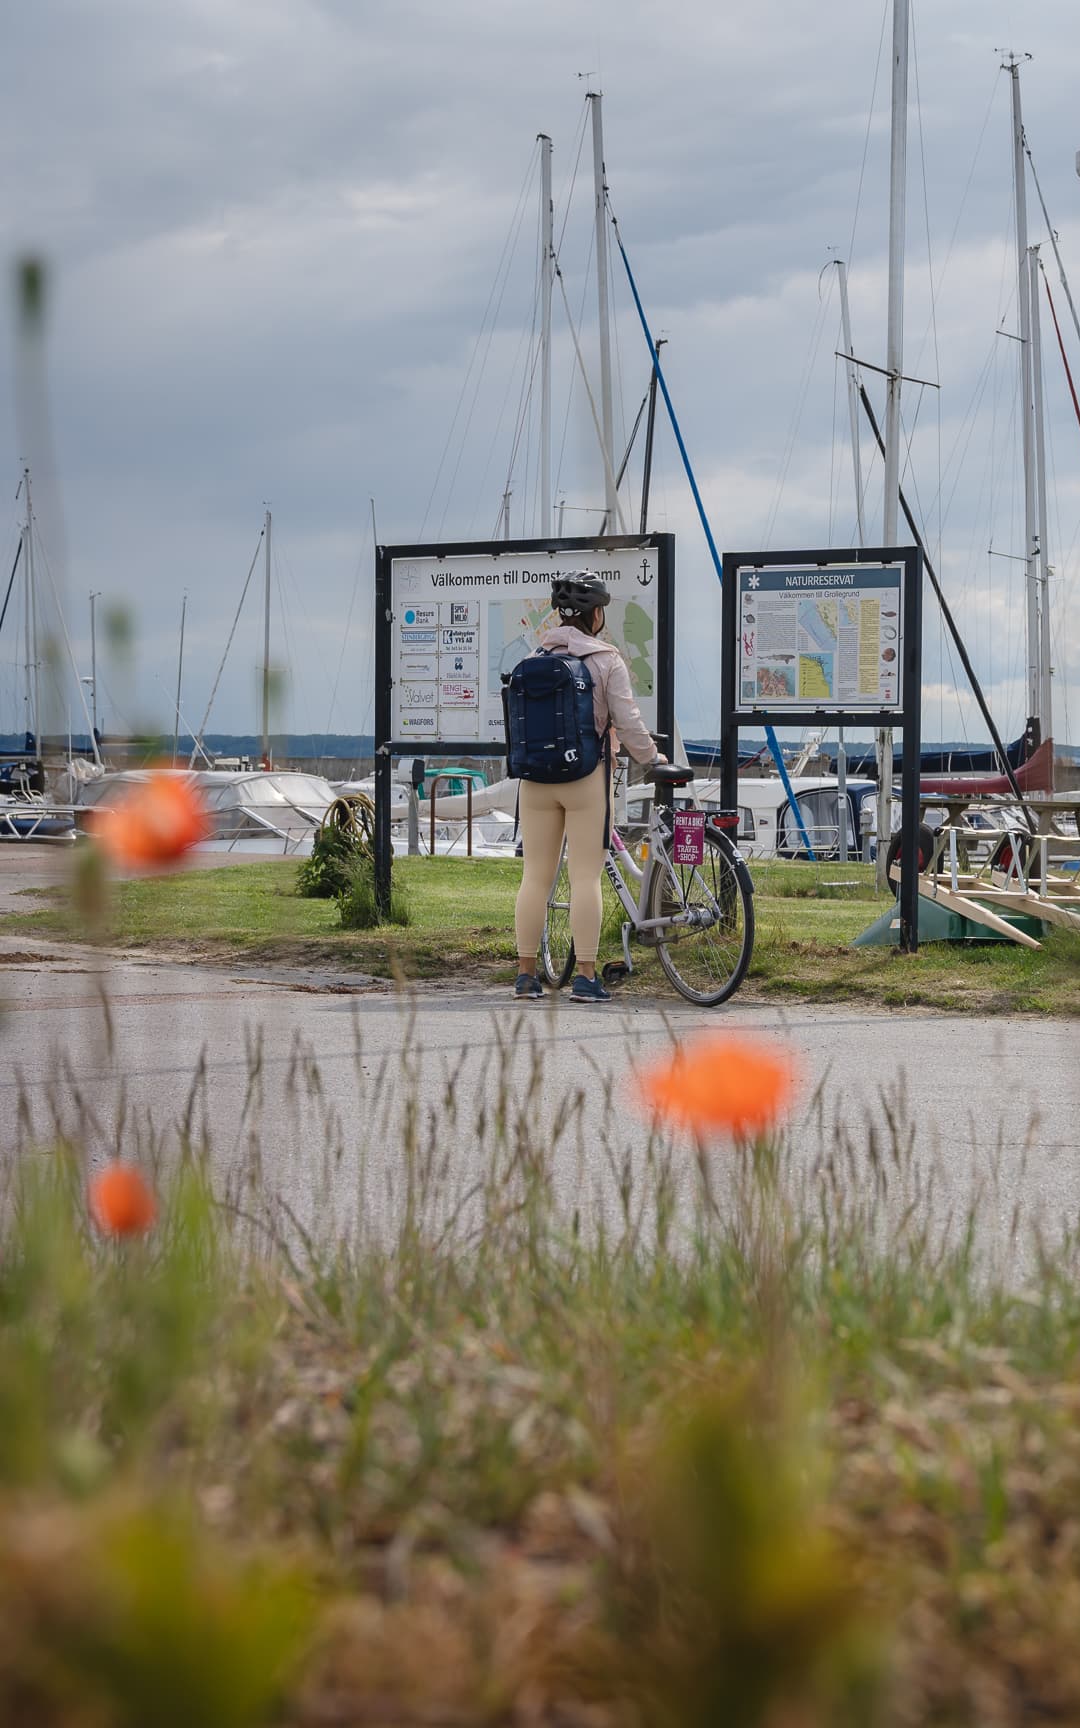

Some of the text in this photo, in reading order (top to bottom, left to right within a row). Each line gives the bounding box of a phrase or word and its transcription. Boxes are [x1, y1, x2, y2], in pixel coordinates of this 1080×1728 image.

[431, 572, 499, 587] Välkommen
[503, 571, 518, 584] till
[786, 576, 855, 586] NATURRESERVAT
[676, 816, 687, 826] RENT
[692, 817, 703, 827] BIKE
[677, 844, 699, 854] TRAVEL
